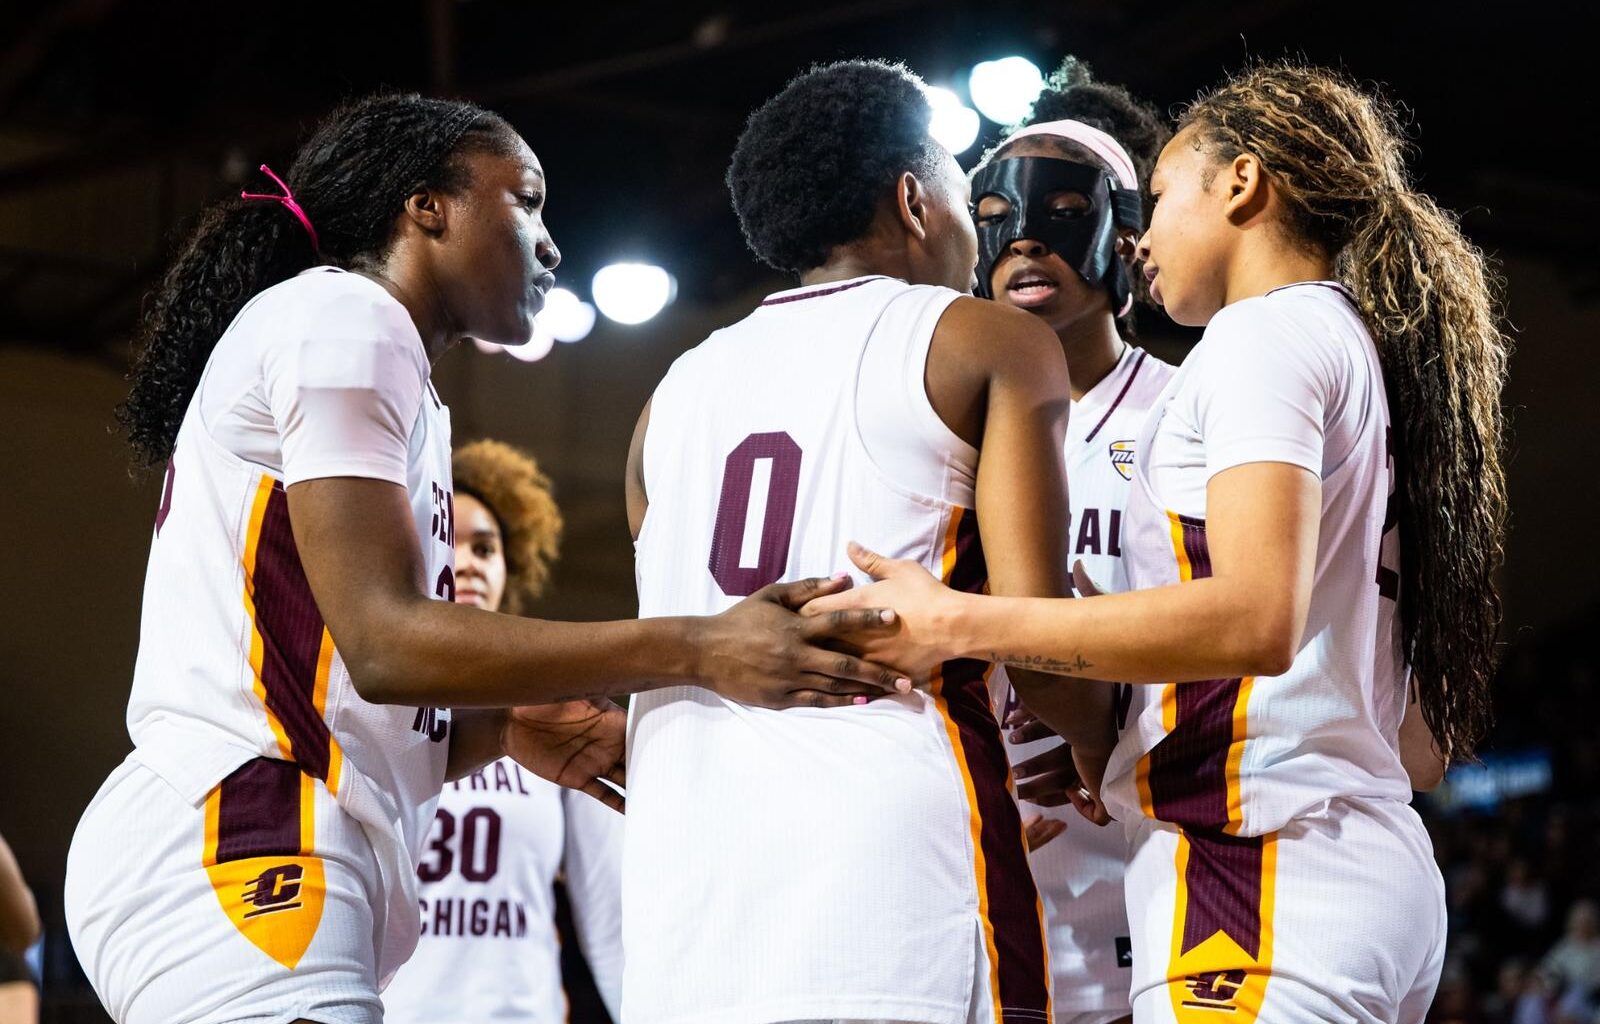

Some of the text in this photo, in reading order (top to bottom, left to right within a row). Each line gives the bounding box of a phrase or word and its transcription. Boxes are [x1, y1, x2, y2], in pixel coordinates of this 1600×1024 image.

[708, 431, 803, 597] 0
[1066, 507, 1122, 557] AL
[416, 807, 502, 882] 30
